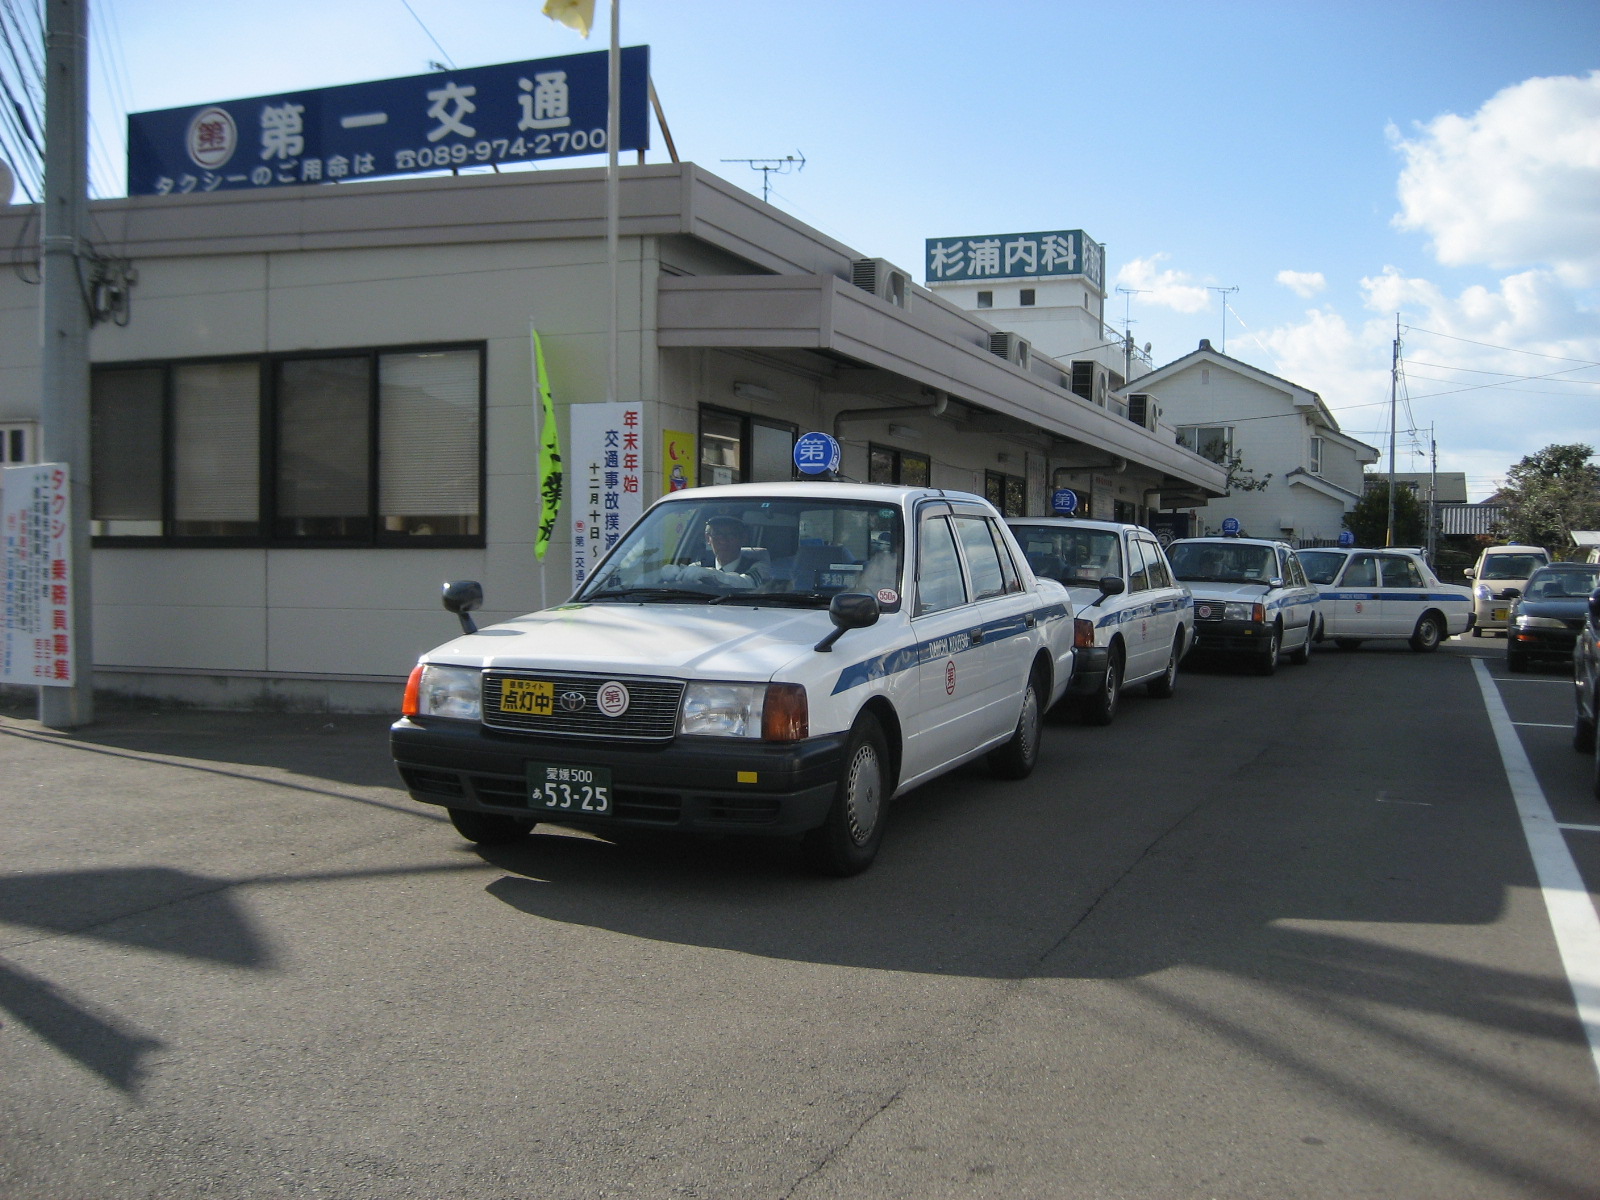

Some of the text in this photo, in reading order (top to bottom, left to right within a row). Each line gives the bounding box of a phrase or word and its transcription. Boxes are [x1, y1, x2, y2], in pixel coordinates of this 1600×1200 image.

[260, 70, 571, 161] 第一交通
[417, 128, 606, 168] 089-974-2700
[155, 153, 375, 196] タクシーのご用命は
[930, 234, 1077, 278] 杉浦内科
[623, 410, 639, 494] 年末年始
[800, 438, 826, 467] 第一
[1055, 492, 1071, 510] 第一
[575, 536, 585, 588] 第一交通
[503, 690, 550, 712] 点灯中
[604, 689, 622, 708] 第一
[532, 783, 608, 812] あ 53-25
